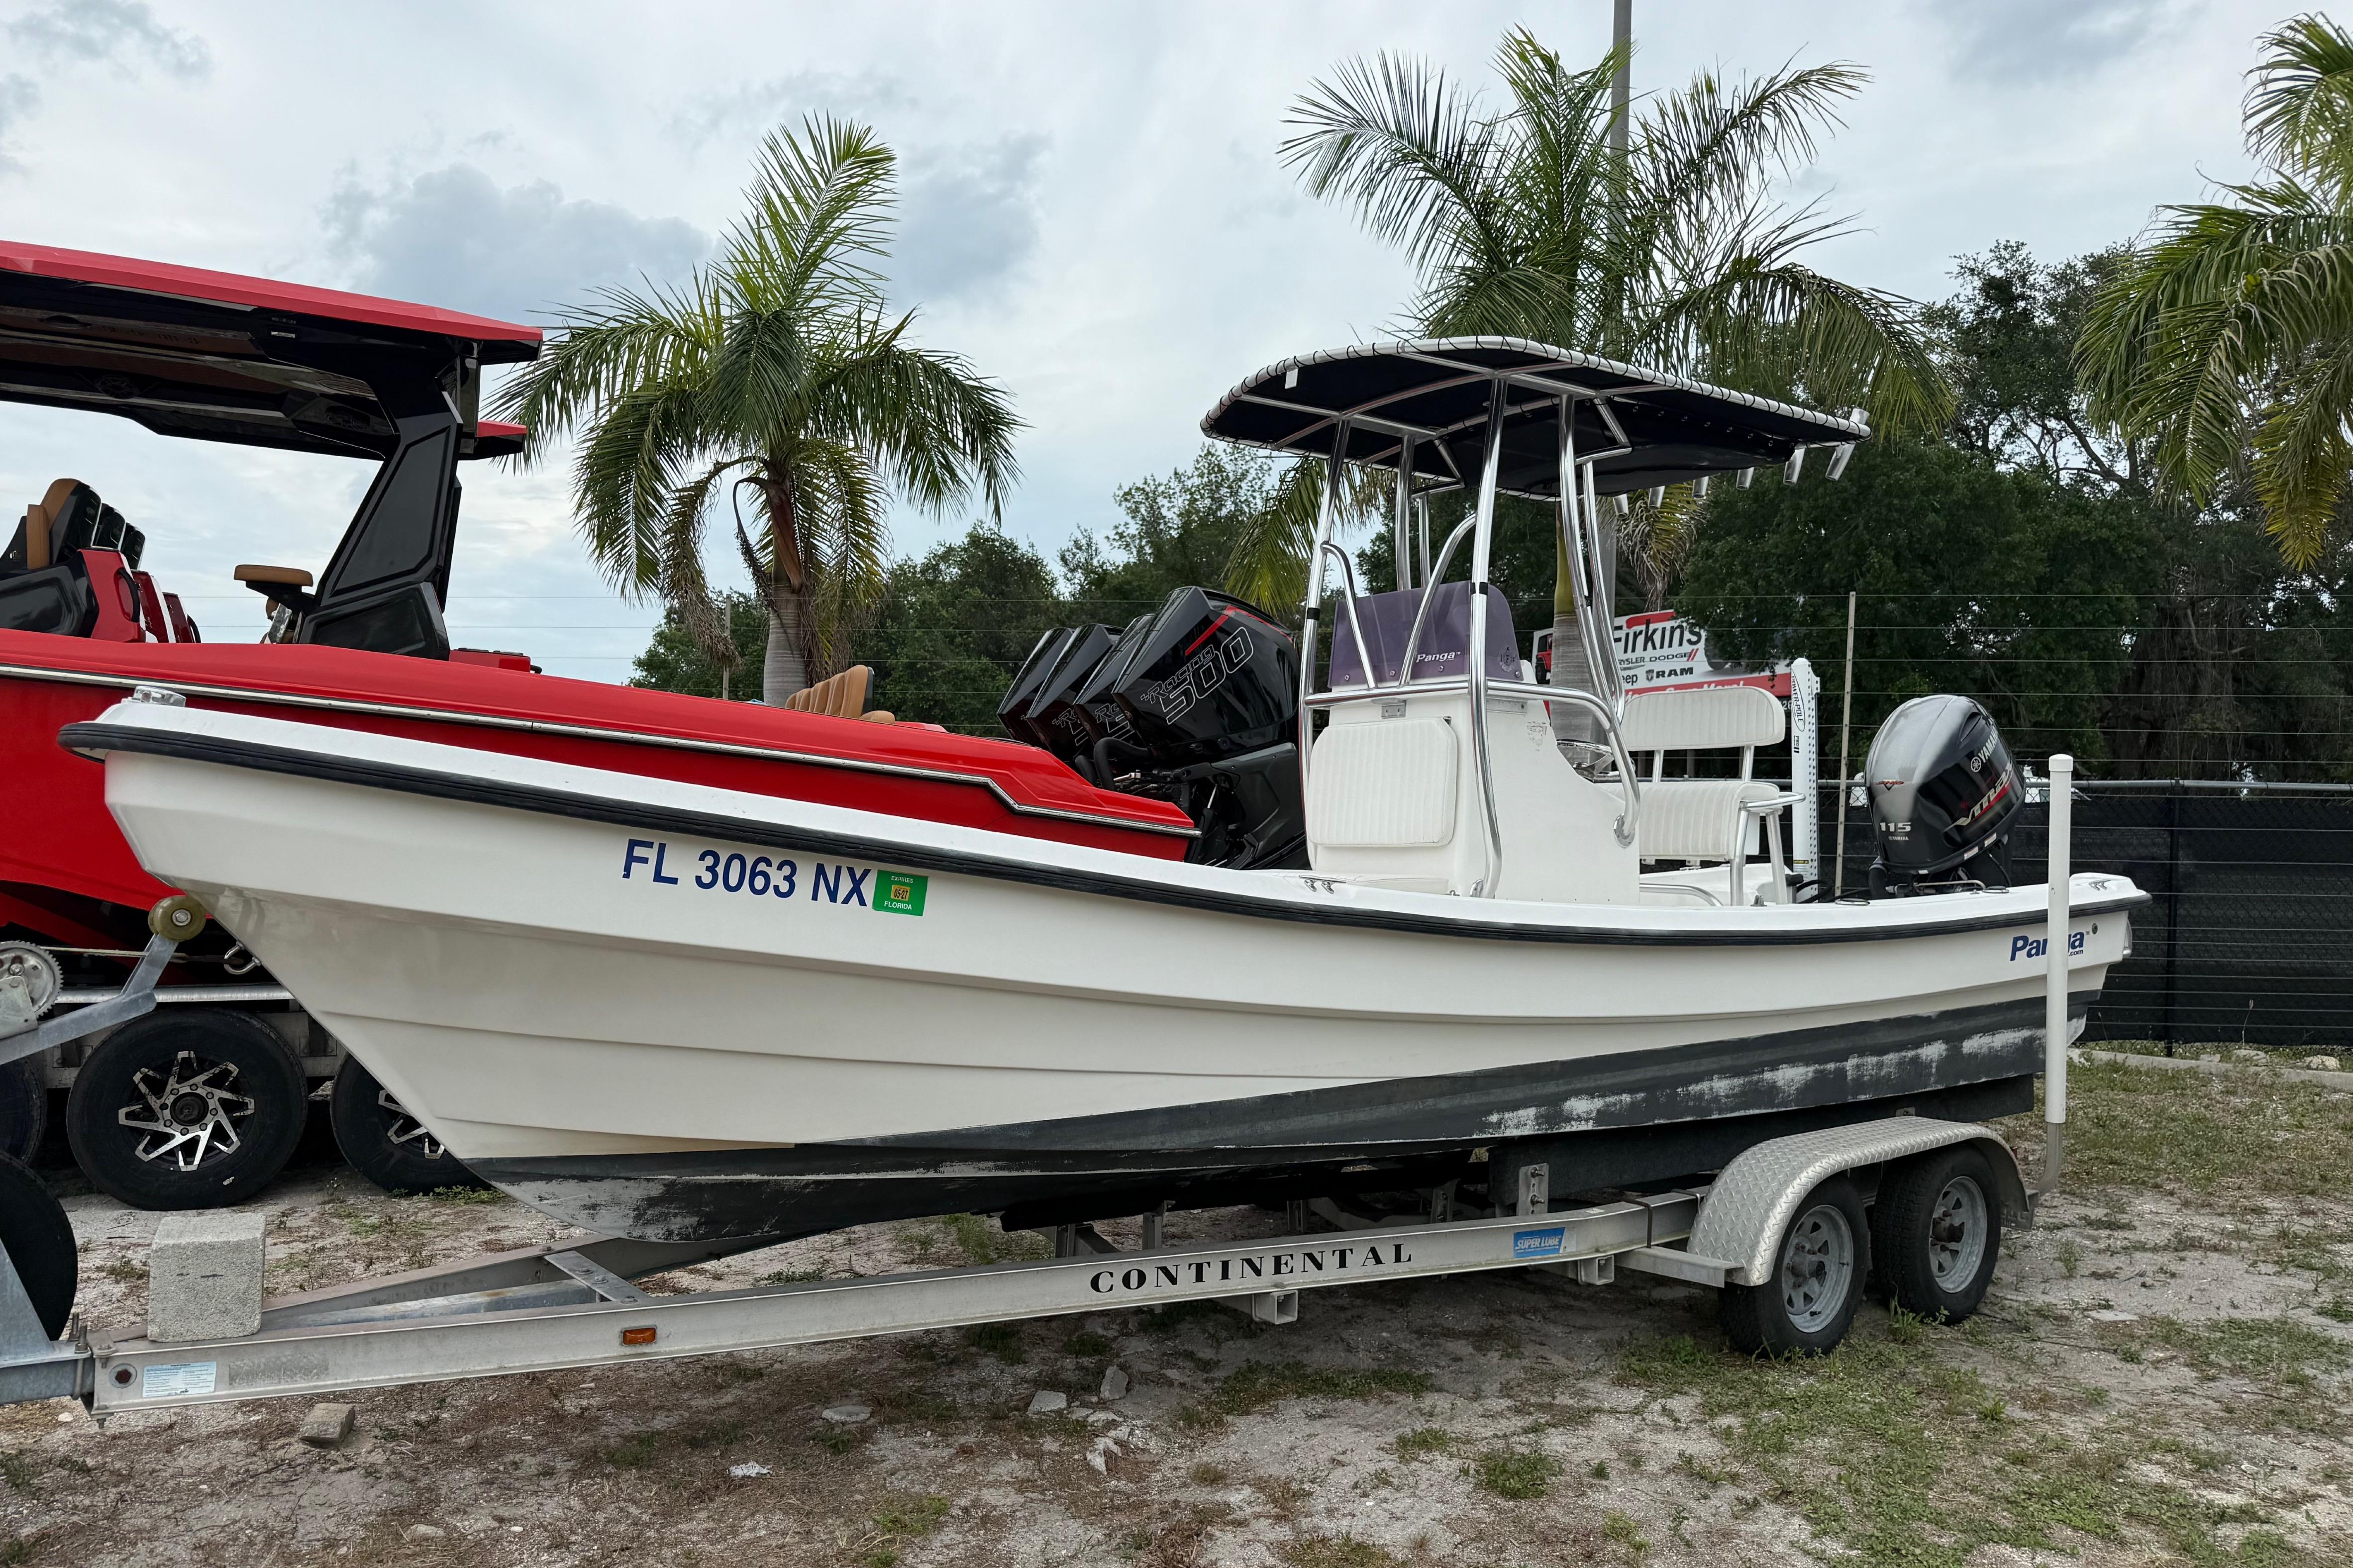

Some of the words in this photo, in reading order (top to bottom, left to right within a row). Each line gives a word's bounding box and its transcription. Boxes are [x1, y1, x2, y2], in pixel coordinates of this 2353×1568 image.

[1416, 652, 1455, 663] Panga
[1618, 656, 1645, 666] RYSLER
[1649, 652, 1690, 662] DODGE
[1147, 644, 1216, 704] Racing
[1159, 626, 1253, 725] 500
[1655, 667, 1694, 679] RAM
[1792, 676, 1804, 723] POWER-POLE
[1880, 822, 1911, 832] 115
[622, 838, 679, 885] FL
[695, 850, 797, 898] 3063
[811, 863, 872, 907] NX
[894, 888, 909, 900] 05-27
[884, 901, 912, 910] FLORIDA
[1515, 1238, 1540, 1250] SUPER
[1541, 1235, 1562, 1247] LUBE
[1090, 1243, 1412, 1293] CONTINENTAL
